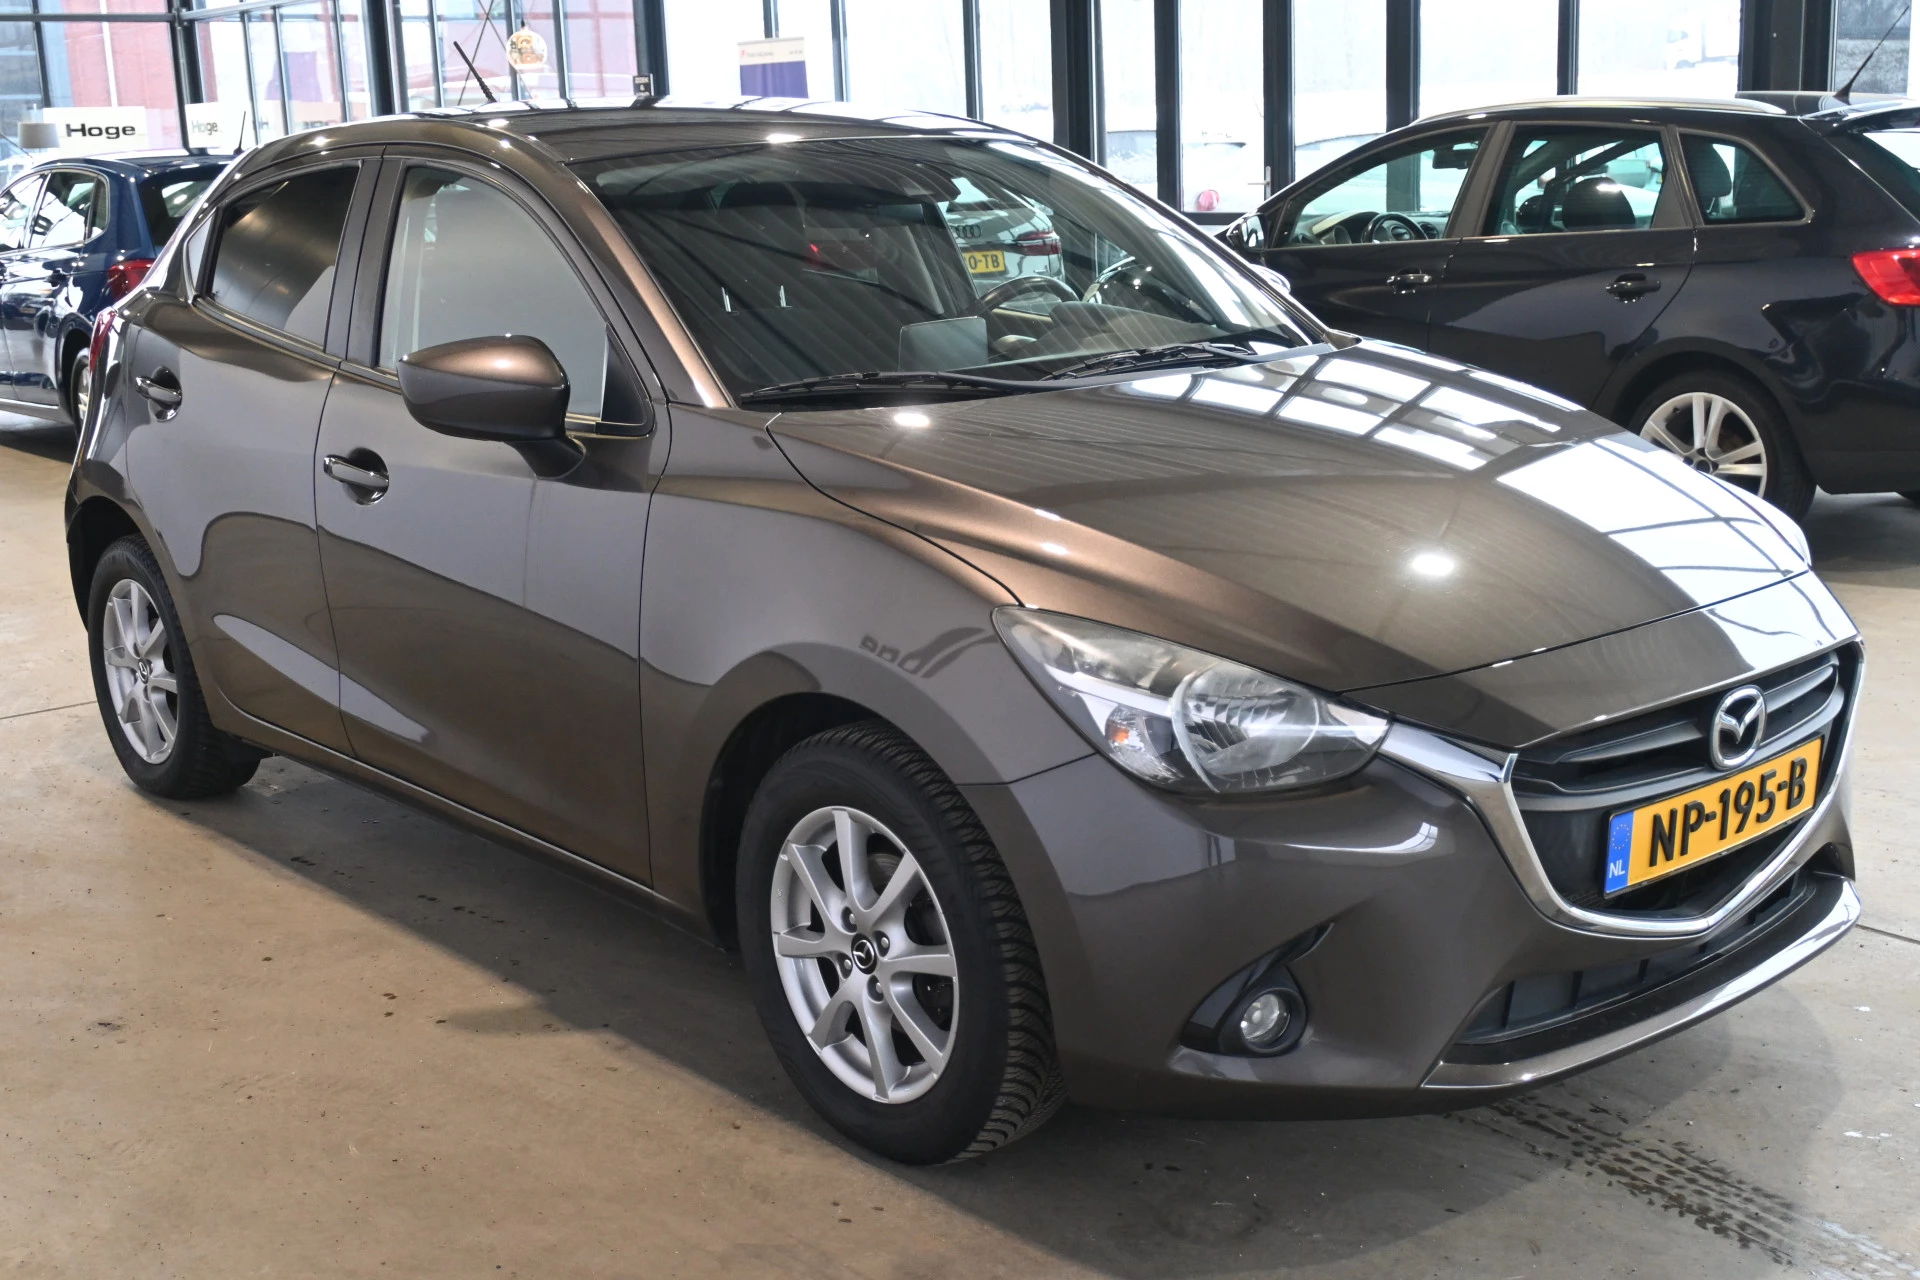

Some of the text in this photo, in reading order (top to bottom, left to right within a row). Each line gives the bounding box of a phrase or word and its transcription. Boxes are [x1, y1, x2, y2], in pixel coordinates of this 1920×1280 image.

[65, 123, 136, 139] Hoge
[1650, 757, 1807, 867] NP-195-B
[1609, 859, 1625, 878] NL
